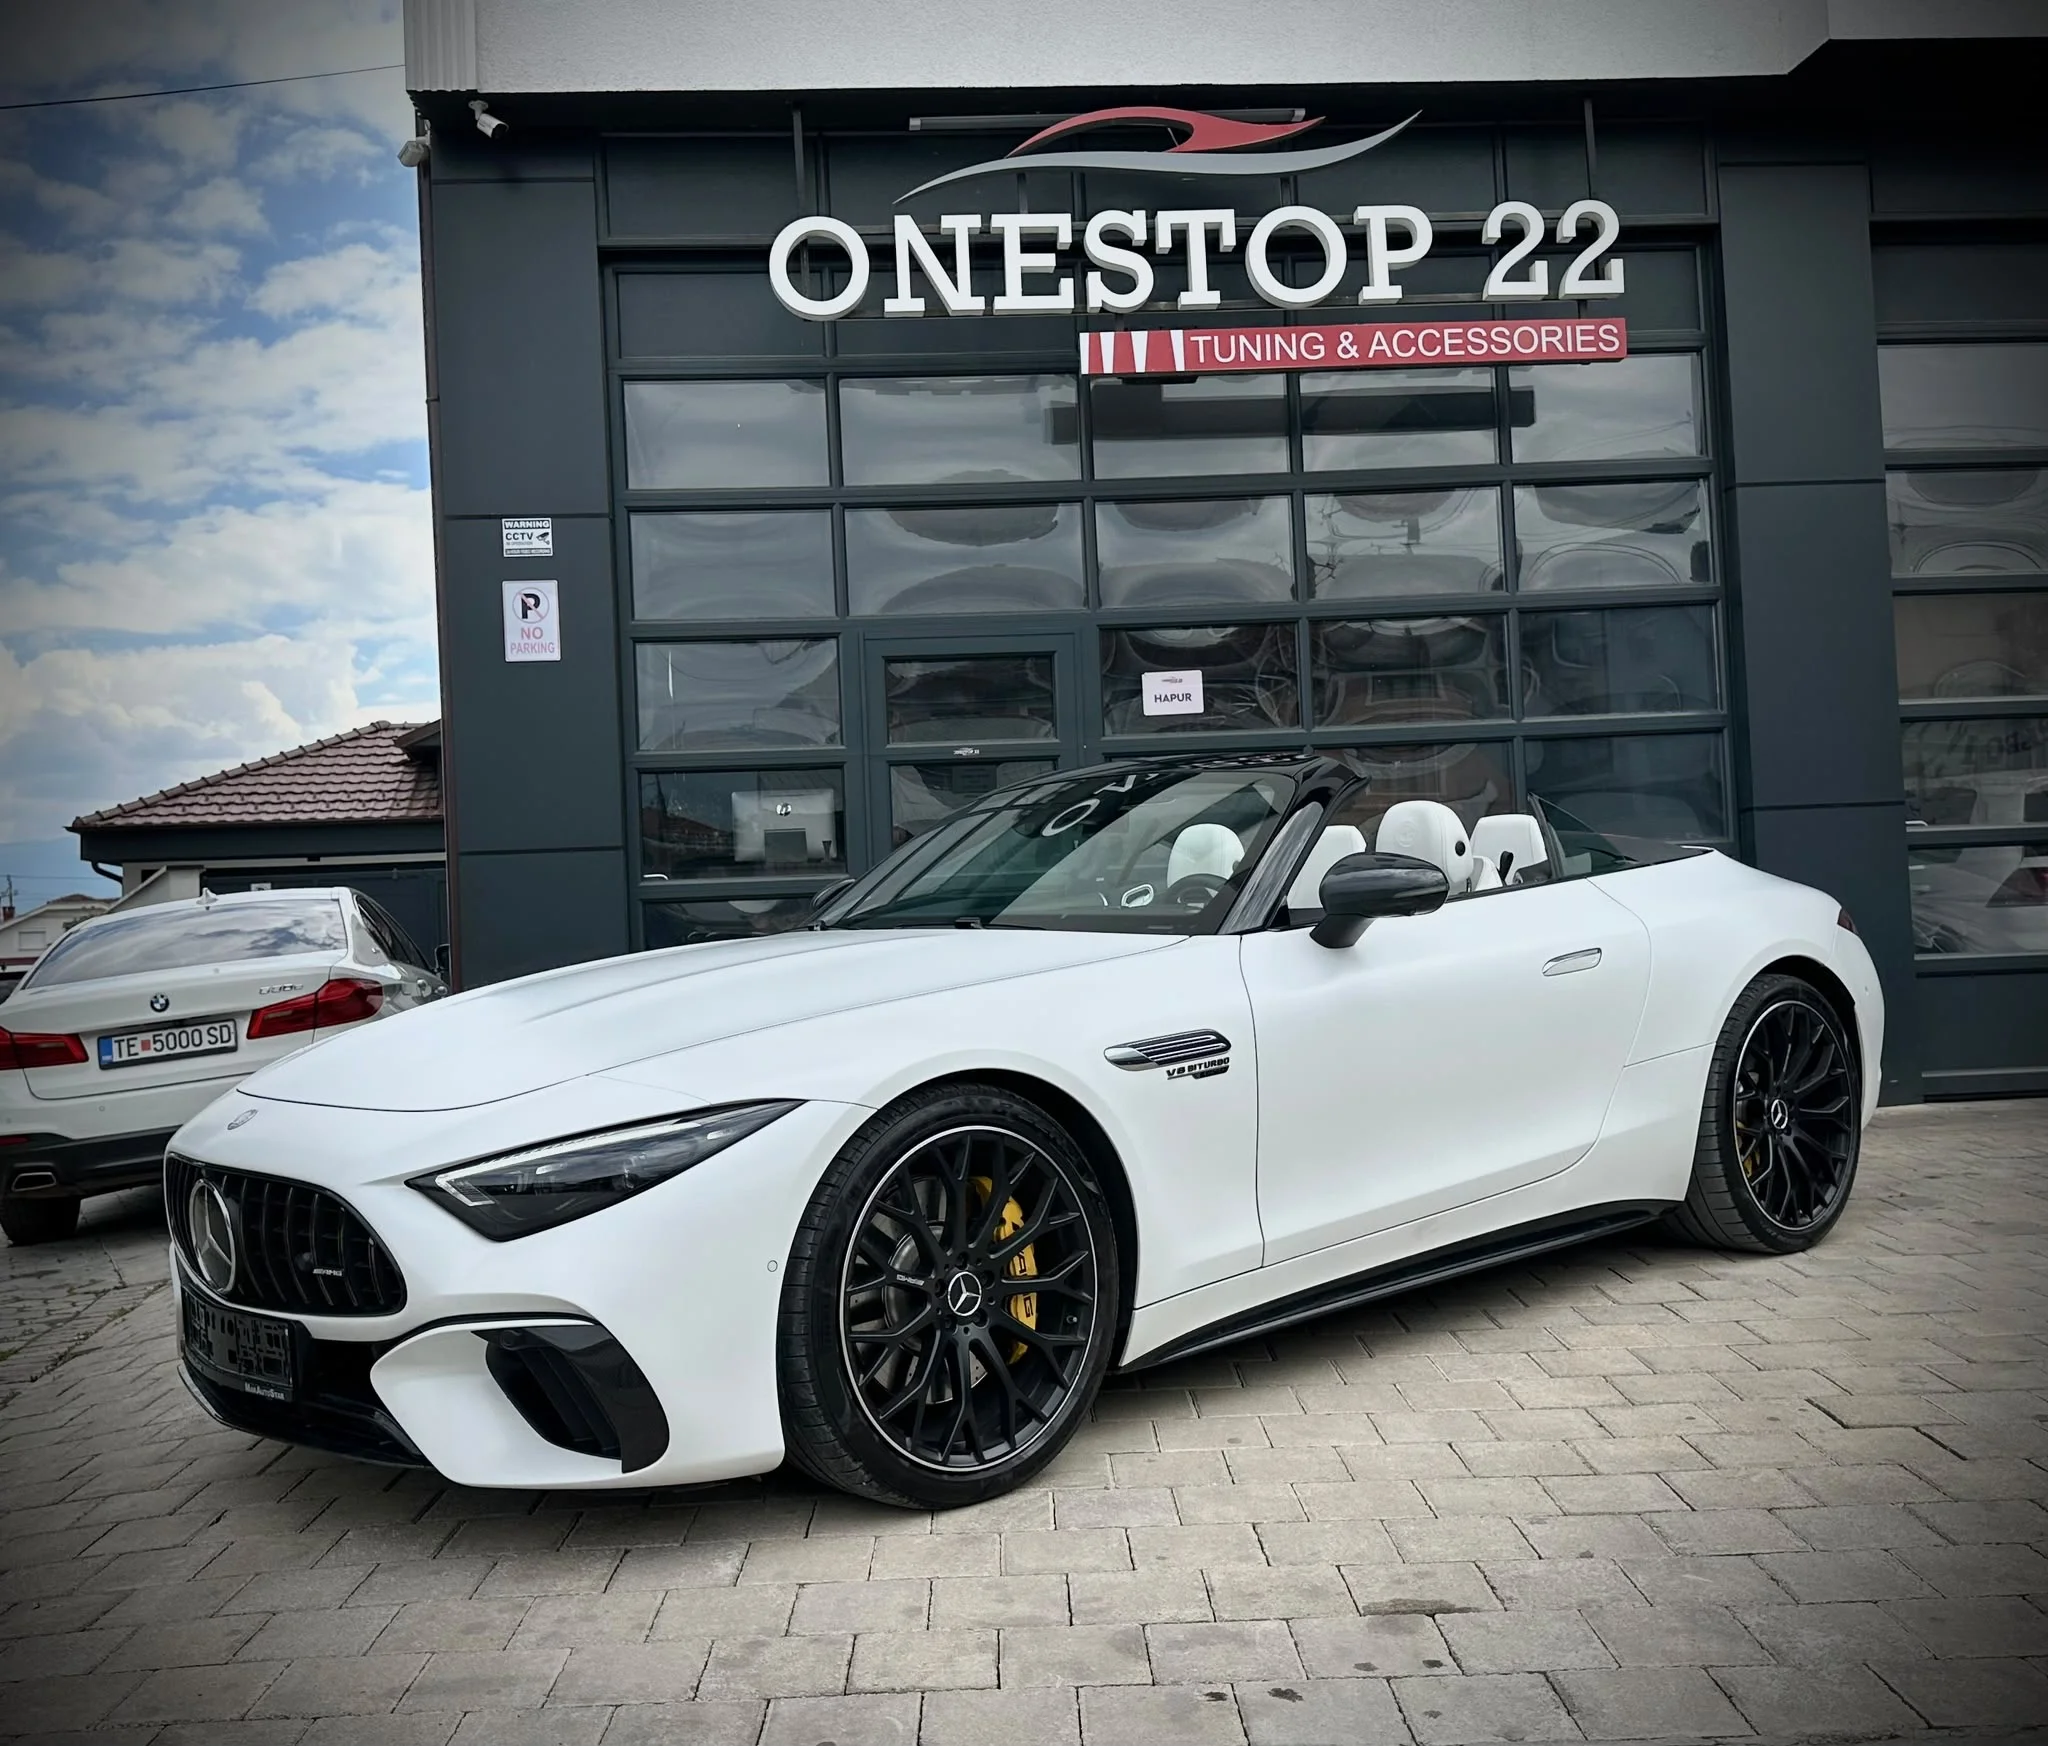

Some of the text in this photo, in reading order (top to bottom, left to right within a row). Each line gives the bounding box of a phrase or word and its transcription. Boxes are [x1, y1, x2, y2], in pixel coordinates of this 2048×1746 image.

[768, 199, 1626, 321] ONESTOP 22
[1190, 324, 1621, 364] TUNING & ACCESSORIES
[505, 520, 550, 529] WARNING
[505, 532, 533, 541] CCTV
[520, 627, 543, 640] NO
[510, 642, 555, 654] PARKING
[1154, 693, 1192, 703] HAPUR
[114, 1024, 232, 1058] TE 5000 SD
[1166, 1066, 1186, 1077] V8
[1187, 1057, 1230, 1072] BITURBO
